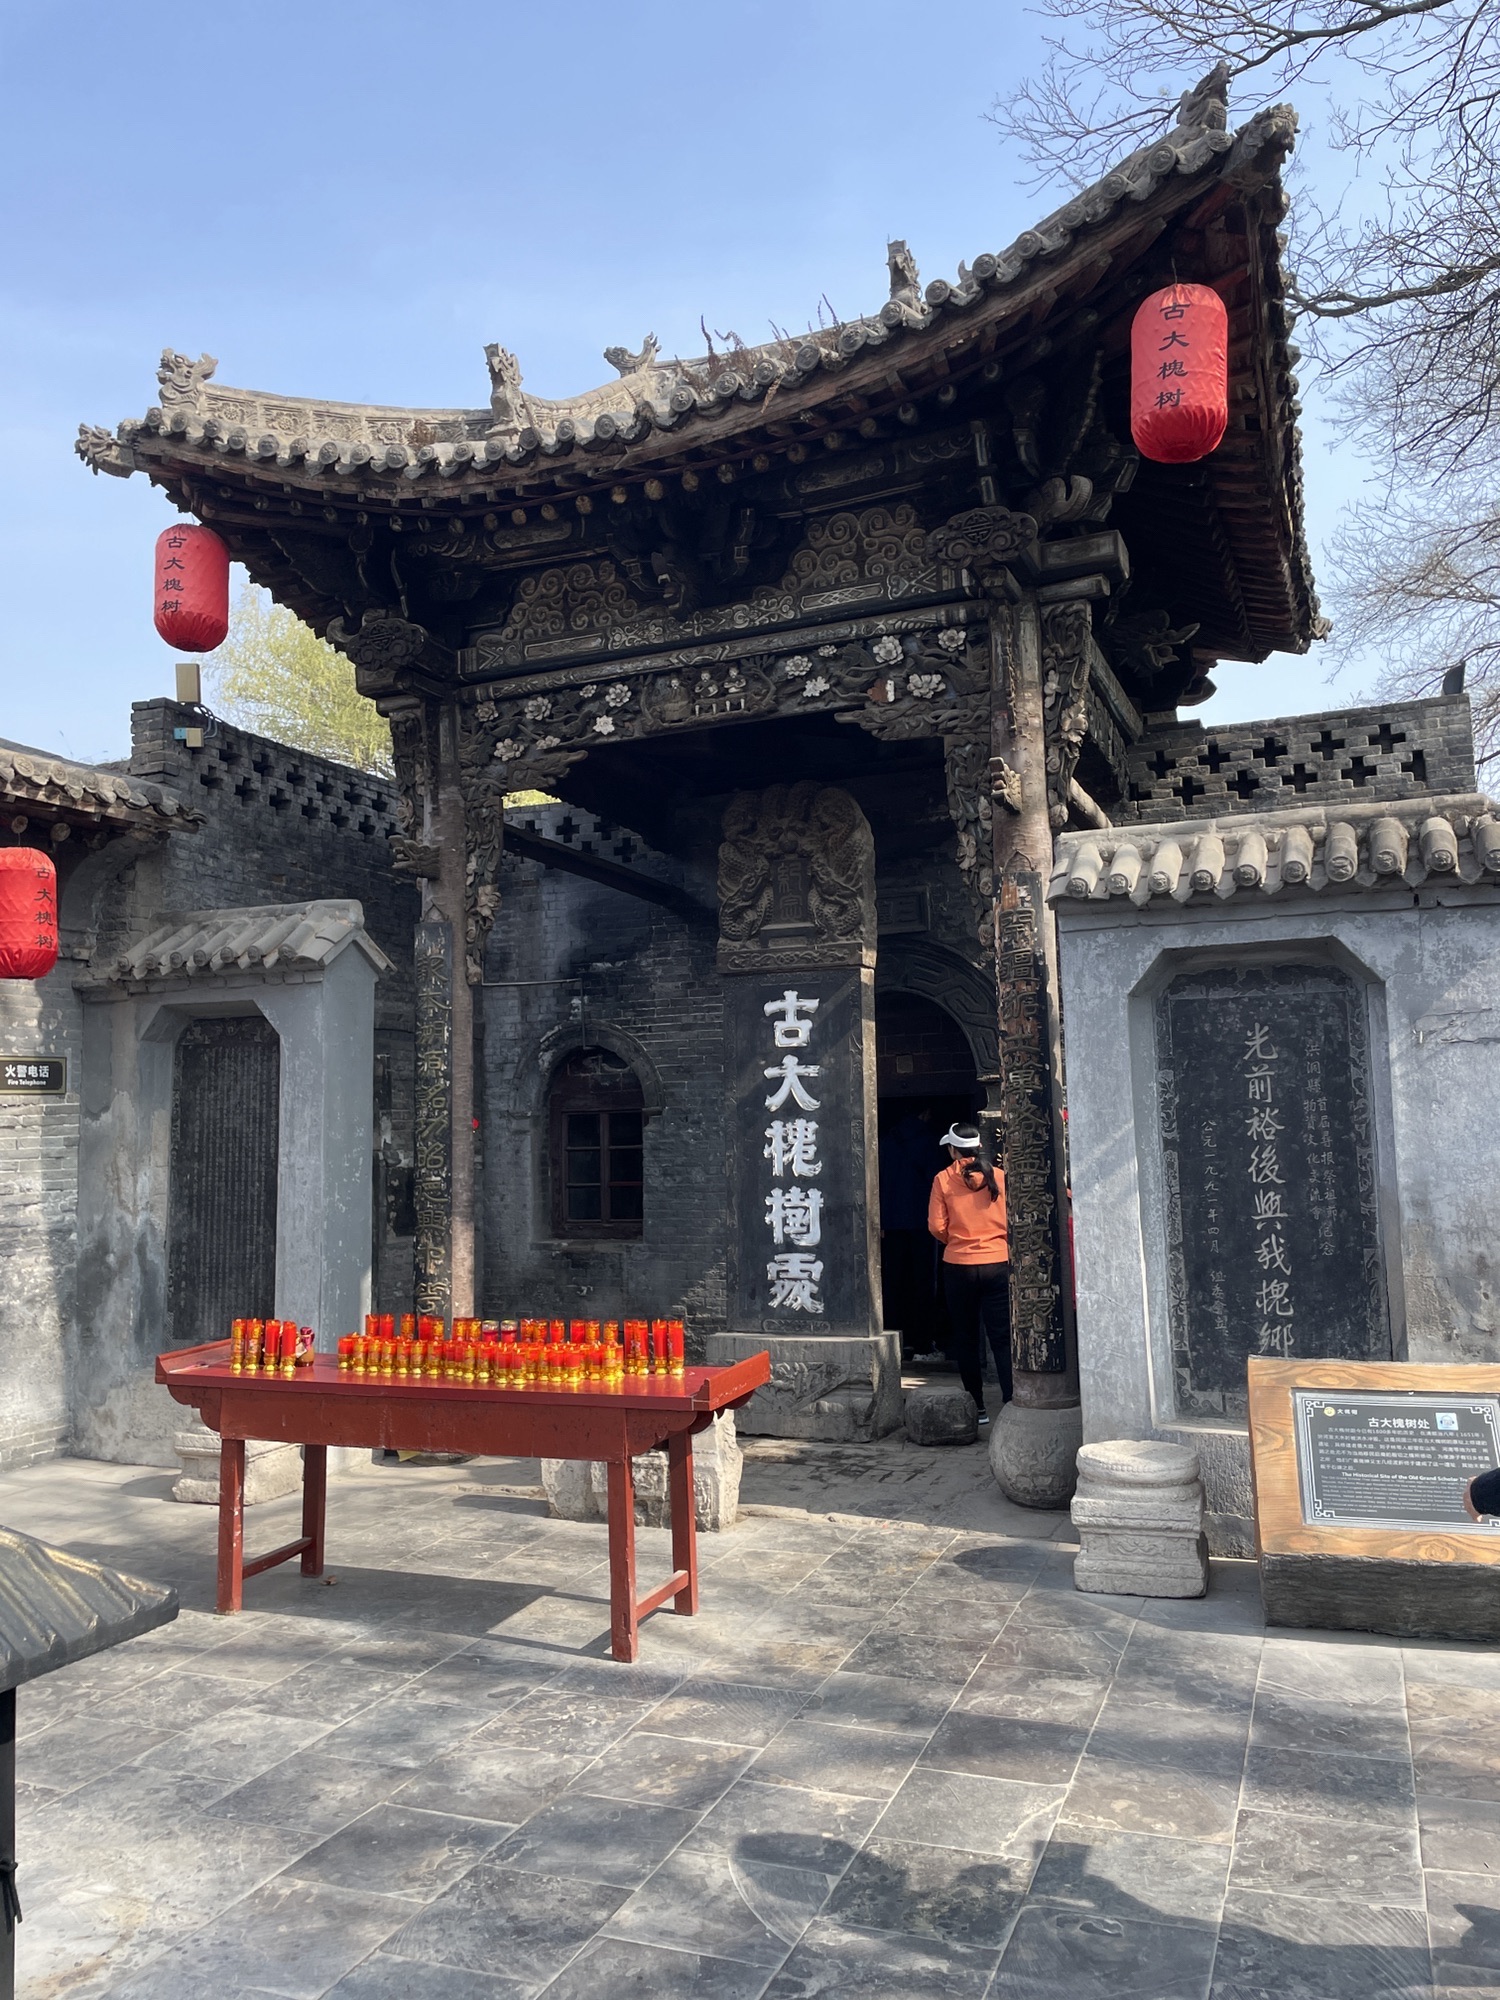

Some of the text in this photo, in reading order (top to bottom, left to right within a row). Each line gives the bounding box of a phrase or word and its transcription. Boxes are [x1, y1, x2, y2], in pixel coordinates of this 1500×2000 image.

[1154, 302, 1190, 409] 古大槐树
[161, 535, 187, 613] 古大槐树
[33, 866, 54, 949] 古大槐树
[5, 1064, 49, 1078] 火警电话
[20, 1079, 46, 1087] Telephone
[1368, 1417, 1431, 1429] 古大槐树处
